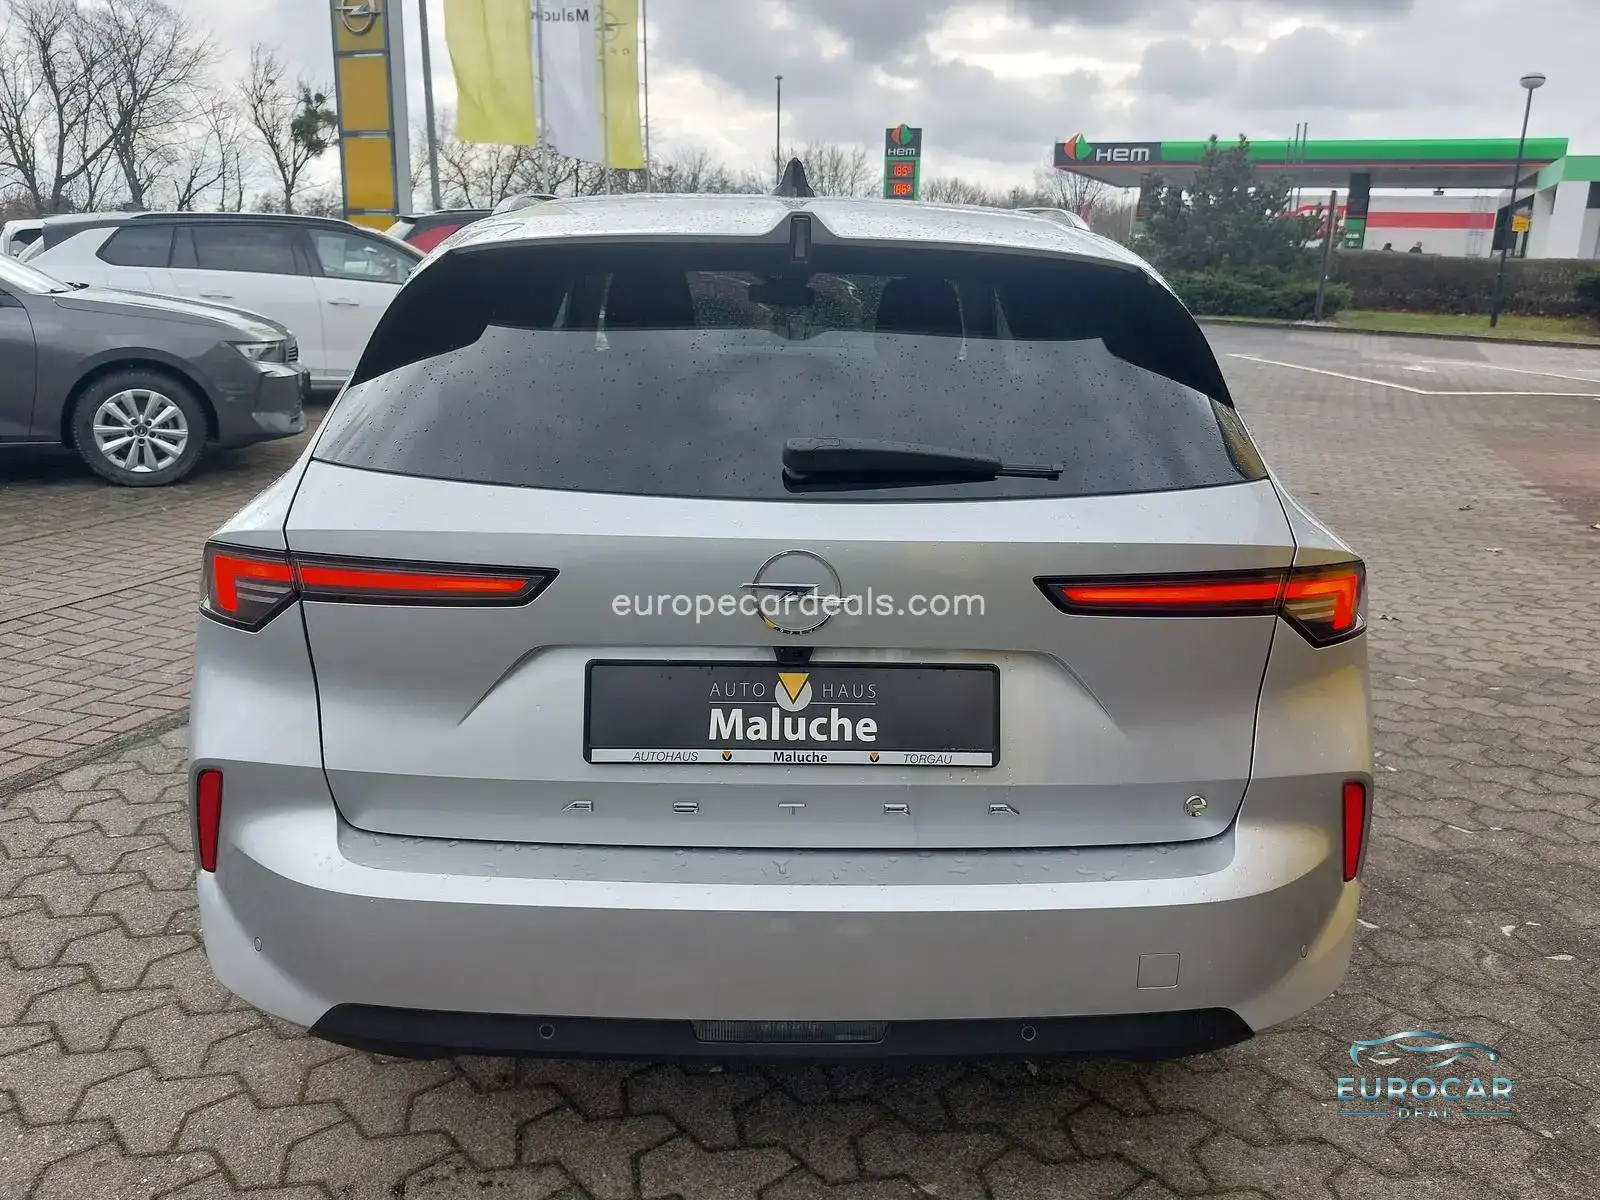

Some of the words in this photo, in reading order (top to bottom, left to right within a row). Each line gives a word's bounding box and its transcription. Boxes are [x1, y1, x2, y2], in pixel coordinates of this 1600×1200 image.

[709, 682, 766, 697] AUTO
[822, 683, 877, 699] HAUS
[708, 706, 878, 743] Maluche
[632, 751, 699, 762] AUTOHAUS
[773, 751, 828, 763] Maluche
[903, 752, 953, 765] TORGAU
[561, 799, 1020, 816] ASTRA
